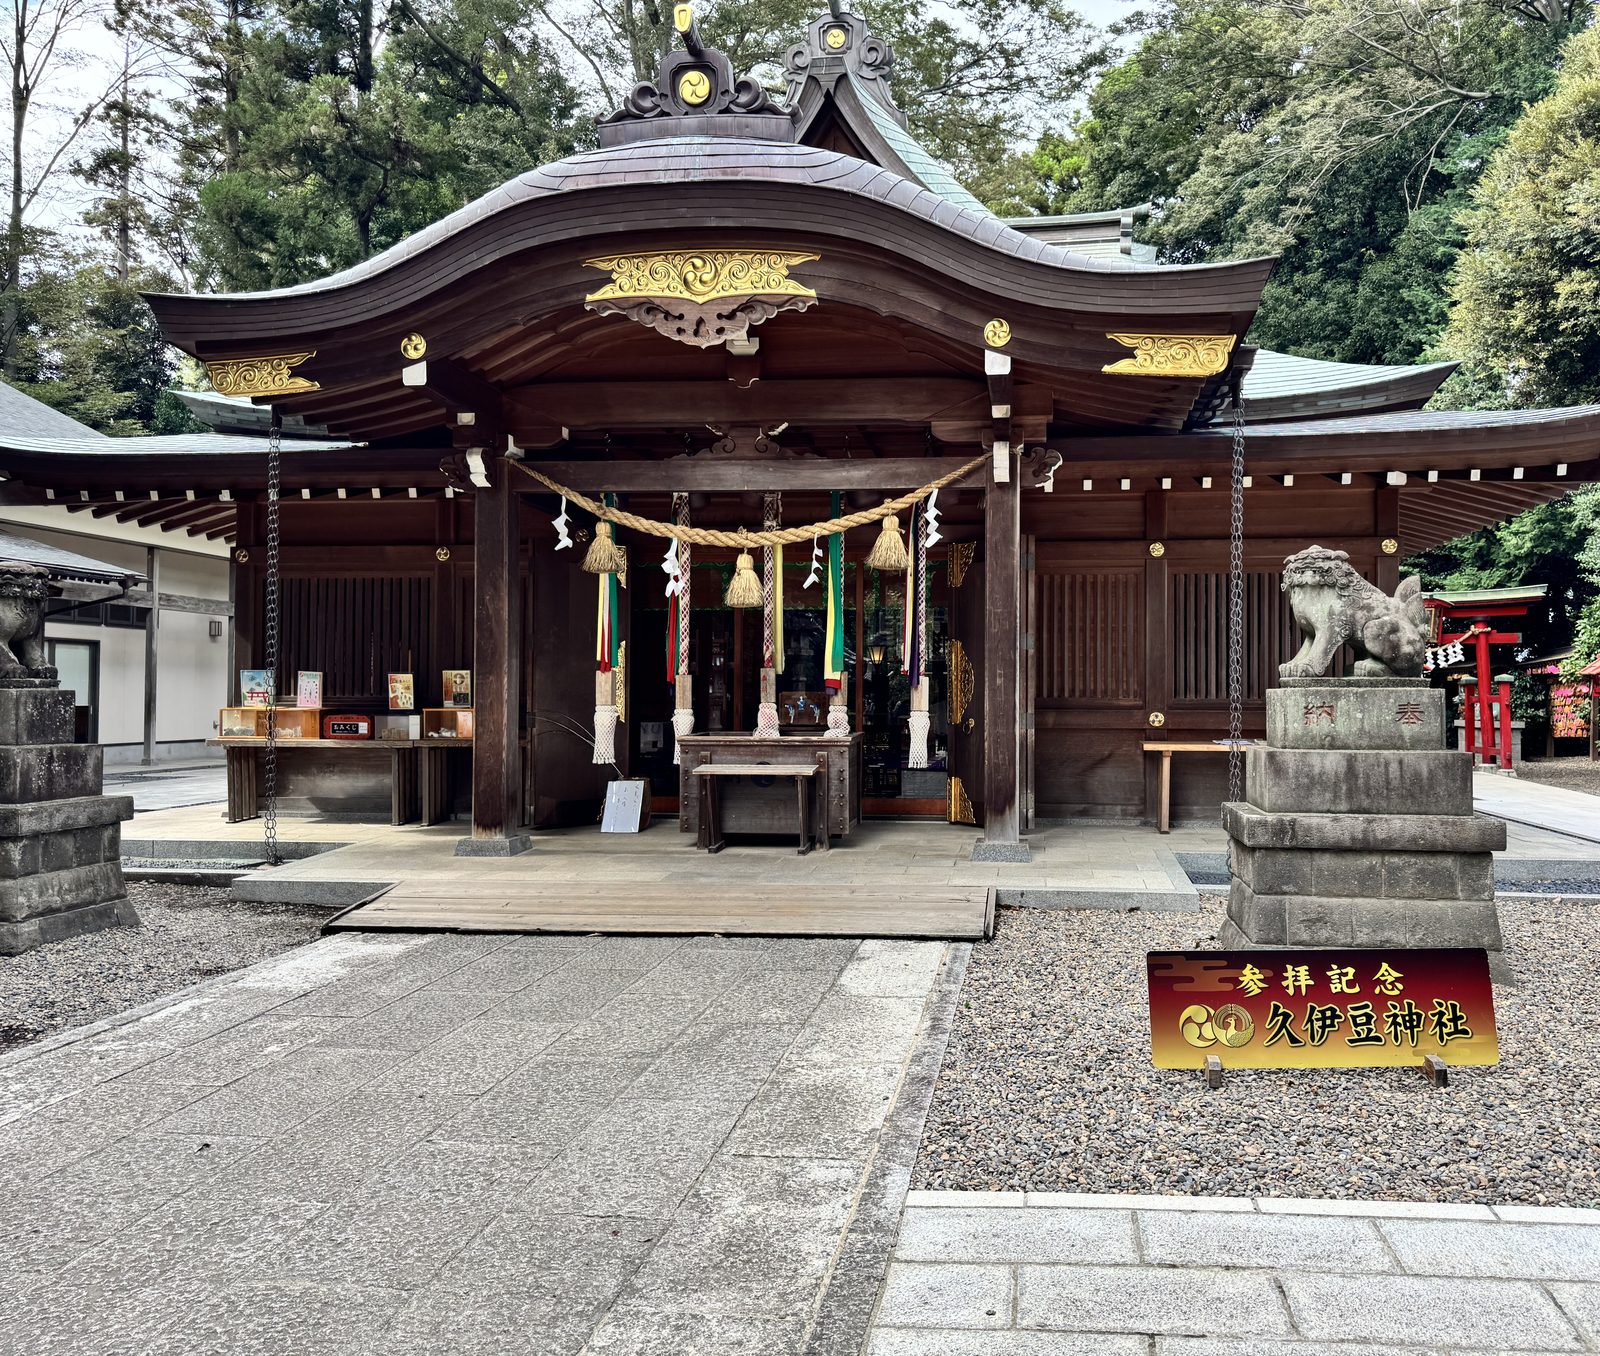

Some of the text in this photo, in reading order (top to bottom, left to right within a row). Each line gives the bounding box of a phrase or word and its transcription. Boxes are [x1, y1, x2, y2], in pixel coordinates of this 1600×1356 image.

[1303, 701, 1336, 726] 納
[1395, 701, 1425, 725] 奉
[1236, 962, 1404, 997] 参拝記念
[1263, 998, 1473, 1047] 久伊豆神社
